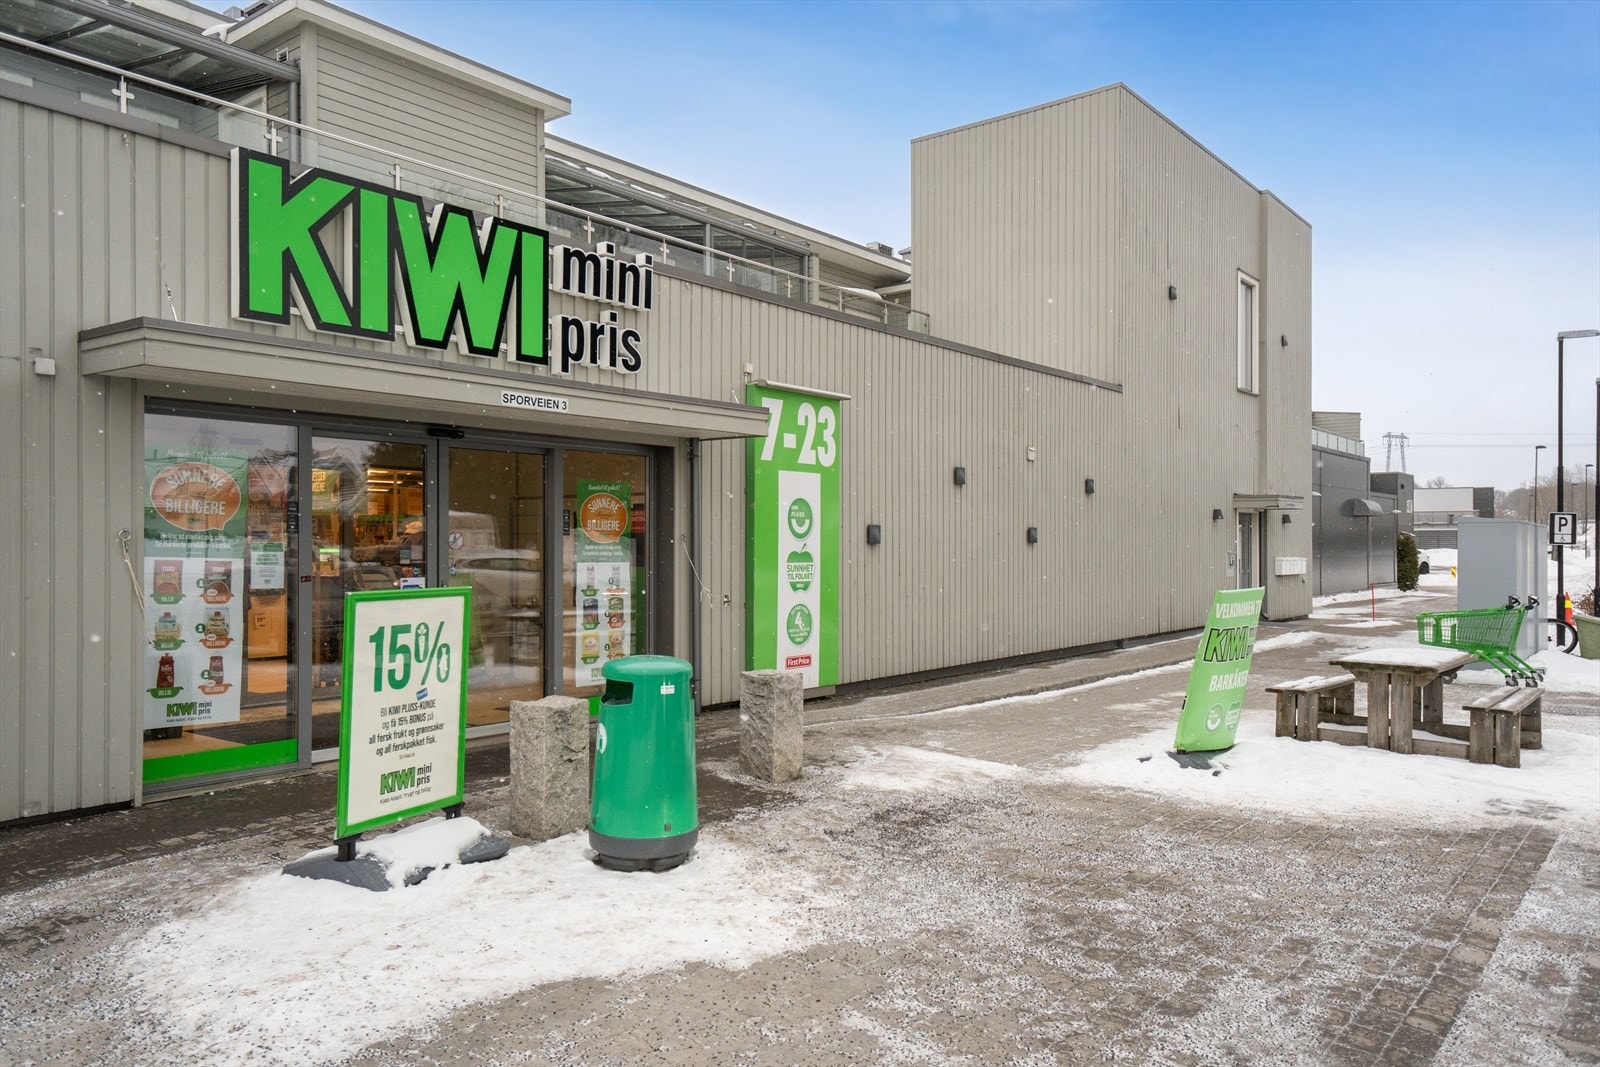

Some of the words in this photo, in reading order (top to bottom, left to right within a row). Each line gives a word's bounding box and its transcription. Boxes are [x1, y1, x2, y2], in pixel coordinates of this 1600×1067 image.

[233, 148, 549, 365] KIWI
[557, 241, 654, 311] mini
[556, 311, 642, 374] pris
[502, 393, 559, 409] SPORVEIEN
[561, 401, 567, 410] 3
[760, 396, 837, 467] 7-23
[166, 469, 227, 490] SUNNERE
[165, 498, 226, 516] BILLIGERE
[587, 498, 620, 513] SUNNERE
[587, 520, 620, 531] BILLIGERE
[1558, 516, 1568, 532] P
[786, 564, 813, 573] SUNNHET
[1216, 600, 1255, 618] VELKOMMEN
[1203, 626, 1248, 662] KIWI
[369, 621, 450, 692] 15%
[787, 658, 798, 666] First
[799, 656, 810, 665] Price
[166, 702, 197, 717] KIWI
[388, 705, 401, 716] KIWI
[401, 699, 436, 713] PLUSS-KUNDE
[382, 721, 389, 730] og
[391, 718, 397, 728] få
[398, 715, 408, 726] 15%
[409, 713, 426, 724] BONUS
[427, 711, 434, 722] på
[368, 734, 376, 744] all
[377, 732, 392, 743] fersk
[393, 728, 407, 740] frukt
[408, 728, 415, 738] og
[416, 722, 445, 736] grønnsaker
[376, 747, 383, 756] og
[392, 738, 425, 752] ferskpakket
[426, 735, 437, 745] fisk.
[417, 762, 432, 776] mini
[380, 766, 416, 795] KIWI
[416, 774, 431, 788] pris
